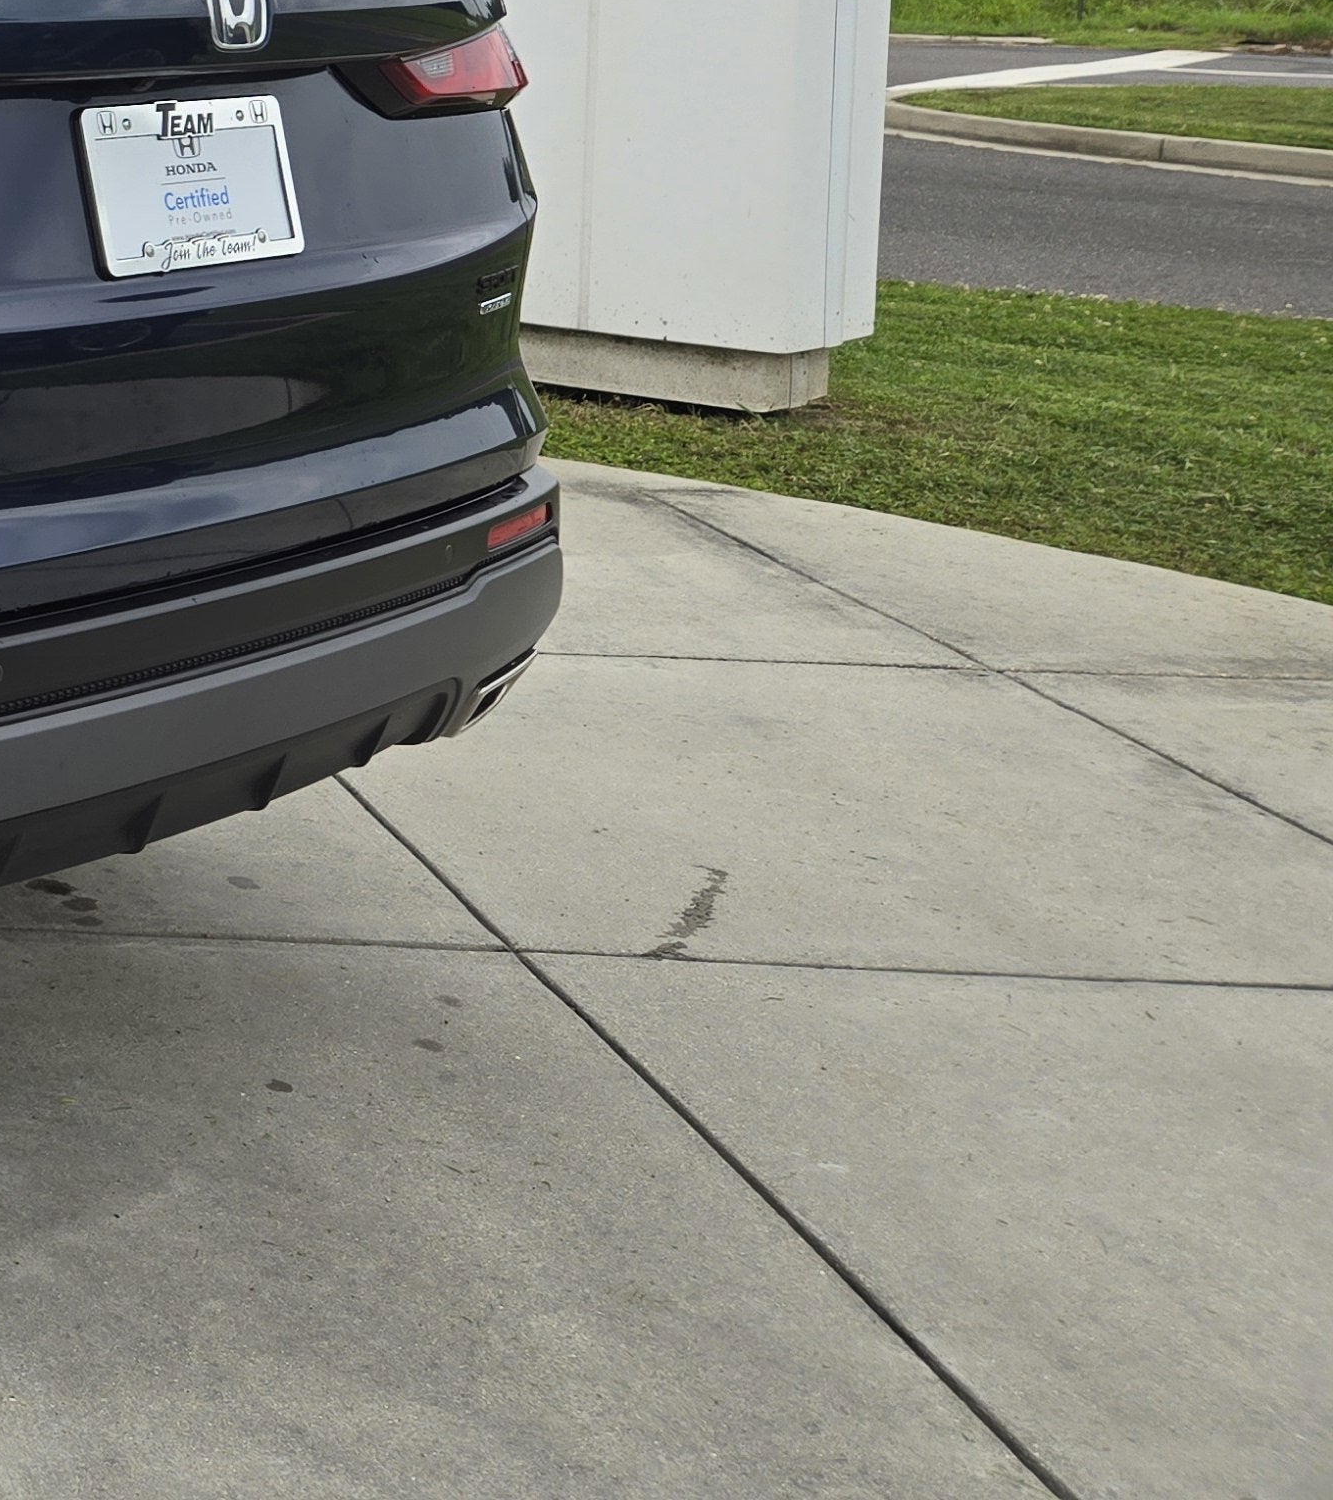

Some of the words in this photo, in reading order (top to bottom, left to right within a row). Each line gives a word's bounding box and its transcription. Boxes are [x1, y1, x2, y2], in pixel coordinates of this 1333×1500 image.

[156, 103, 214, 137] TEAM
[165, 162, 217, 176] HONDA
[164, 185, 230, 211] Certified
[168, 209, 233, 226] Pre-Owned
[161, 242, 191, 270] Join
[192, 239, 217, 260] The
[217, 235, 257, 256] Team!
